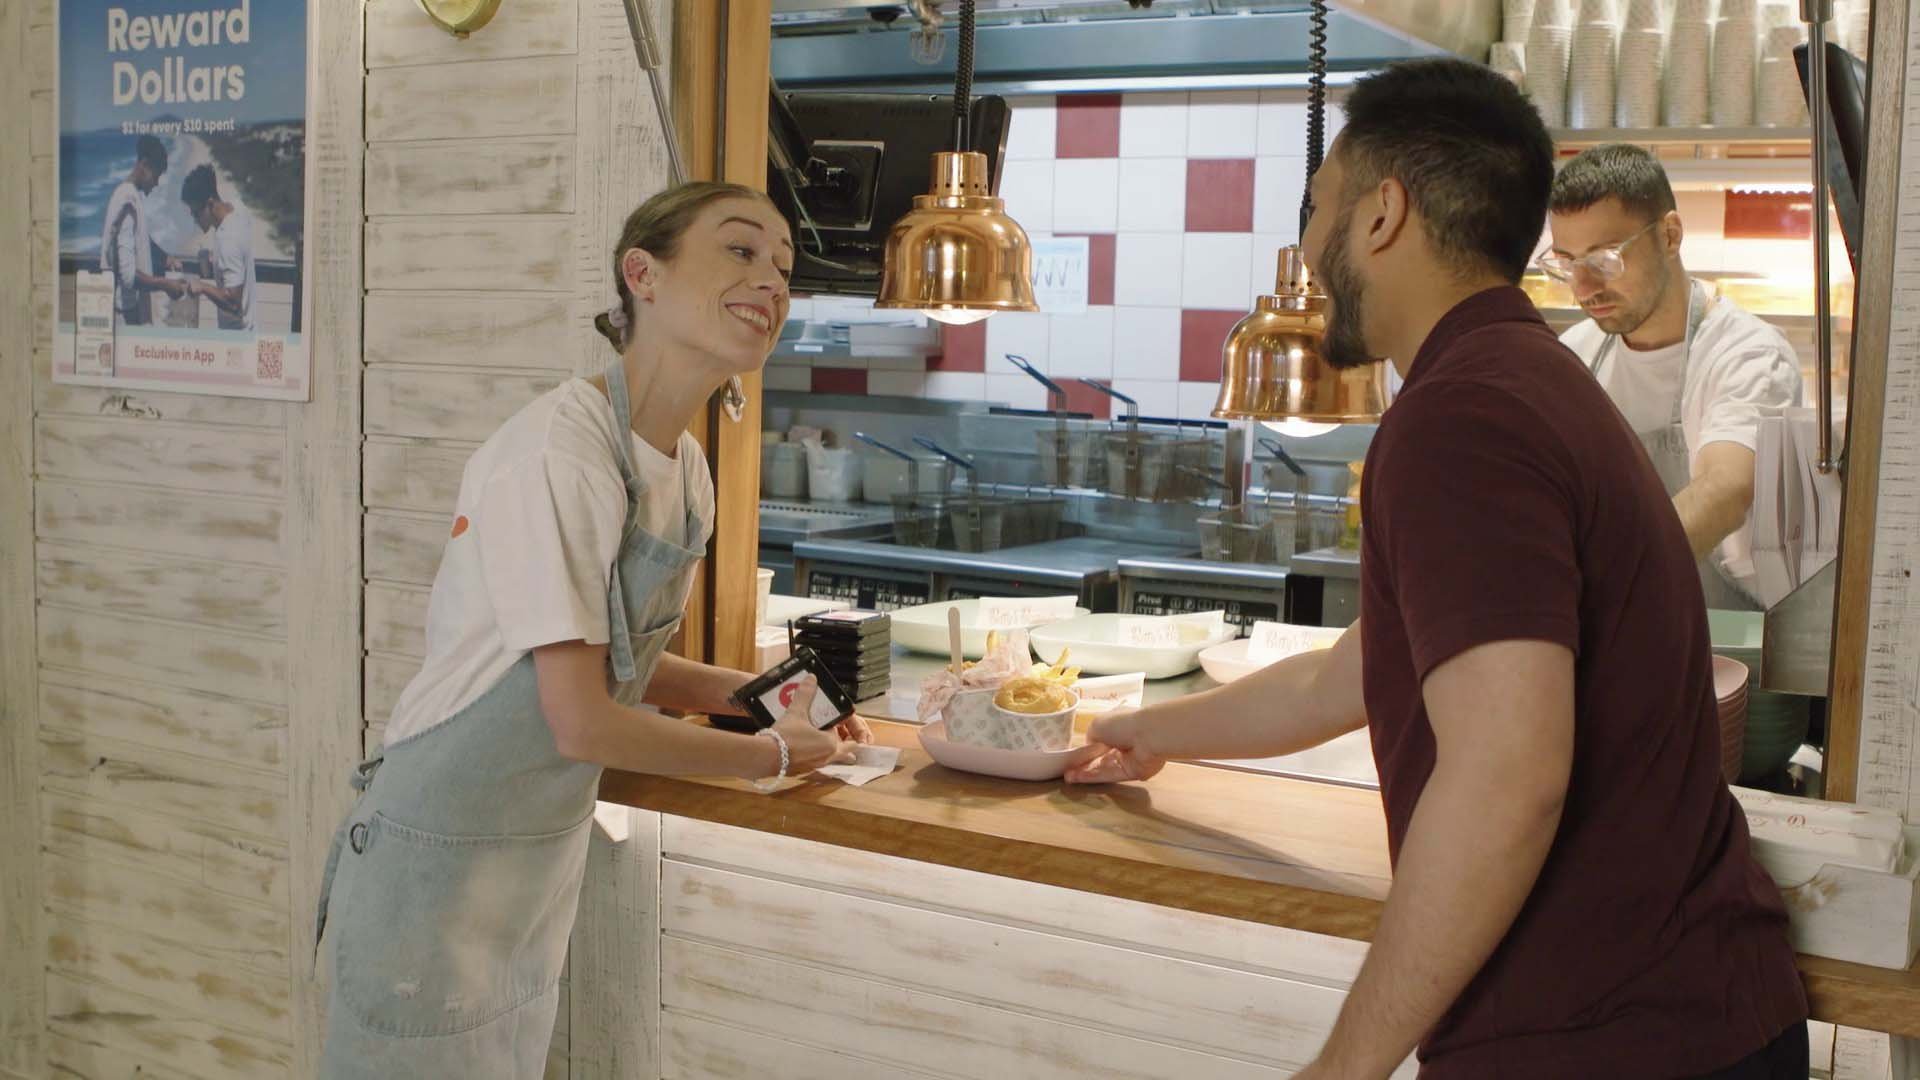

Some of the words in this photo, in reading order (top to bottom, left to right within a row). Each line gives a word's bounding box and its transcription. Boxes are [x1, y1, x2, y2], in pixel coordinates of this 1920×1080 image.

[108, 0, 250, 52] Reward
[113, 56, 245, 106] Dollars
[121, 120, 134, 135] $1
[136, 120, 150, 134] for
[151, 121, 181, 136] every
[183, 118, 202, 132] $10
[204, 117, 235, 134] spent
[134, 345, 180, 361] Exclusive
[182, 348, 192, 361] in
[193, 350, 215, 367] App
